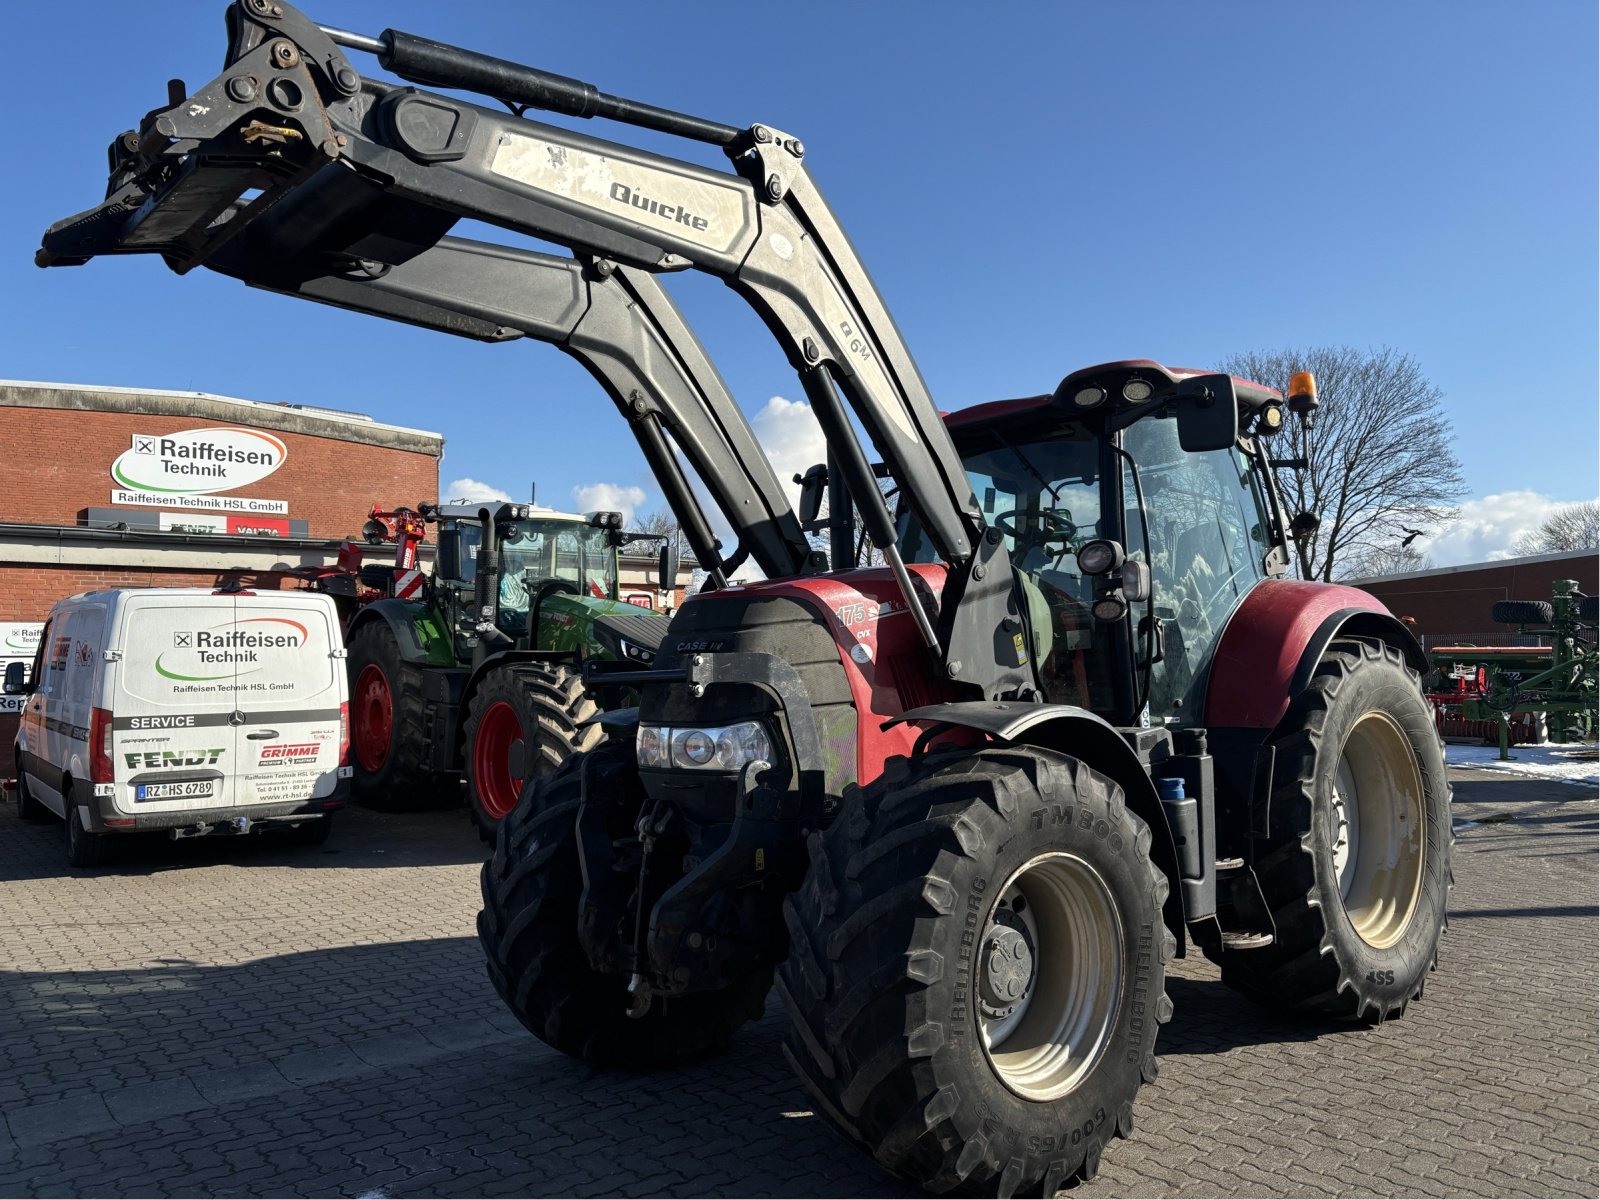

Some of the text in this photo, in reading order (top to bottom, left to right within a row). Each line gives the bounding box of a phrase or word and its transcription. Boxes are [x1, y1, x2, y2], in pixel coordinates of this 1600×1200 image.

[610, 182, 708, 231] Quicke
[160, 438, 273, 466] Raiffeisen
[161, 459, 227, 478] Technik
[118, 492, 283, 512] Raiffeisen Technik HSL GmbH
[836, 602, 866, 628] 175
[197, 631, 298, 648] Raiffeisen
[856, 630, 871, 639] CVX
[677, 641, 708, 651] CASE
[197, 650, 258, 663] Technik
[173, 682, 295, 693] Raiffeisen Technik HSL GmbH
[130, 716, 195, 729] SERVICE
[124, 748, 226, 769] FENDT
[147, 782, 212, 798] RZ HS 6789
[951, 874, 988, 1038] TRELLEBORG
[1127, 920, 1154, 1065] TRELLEBORG
